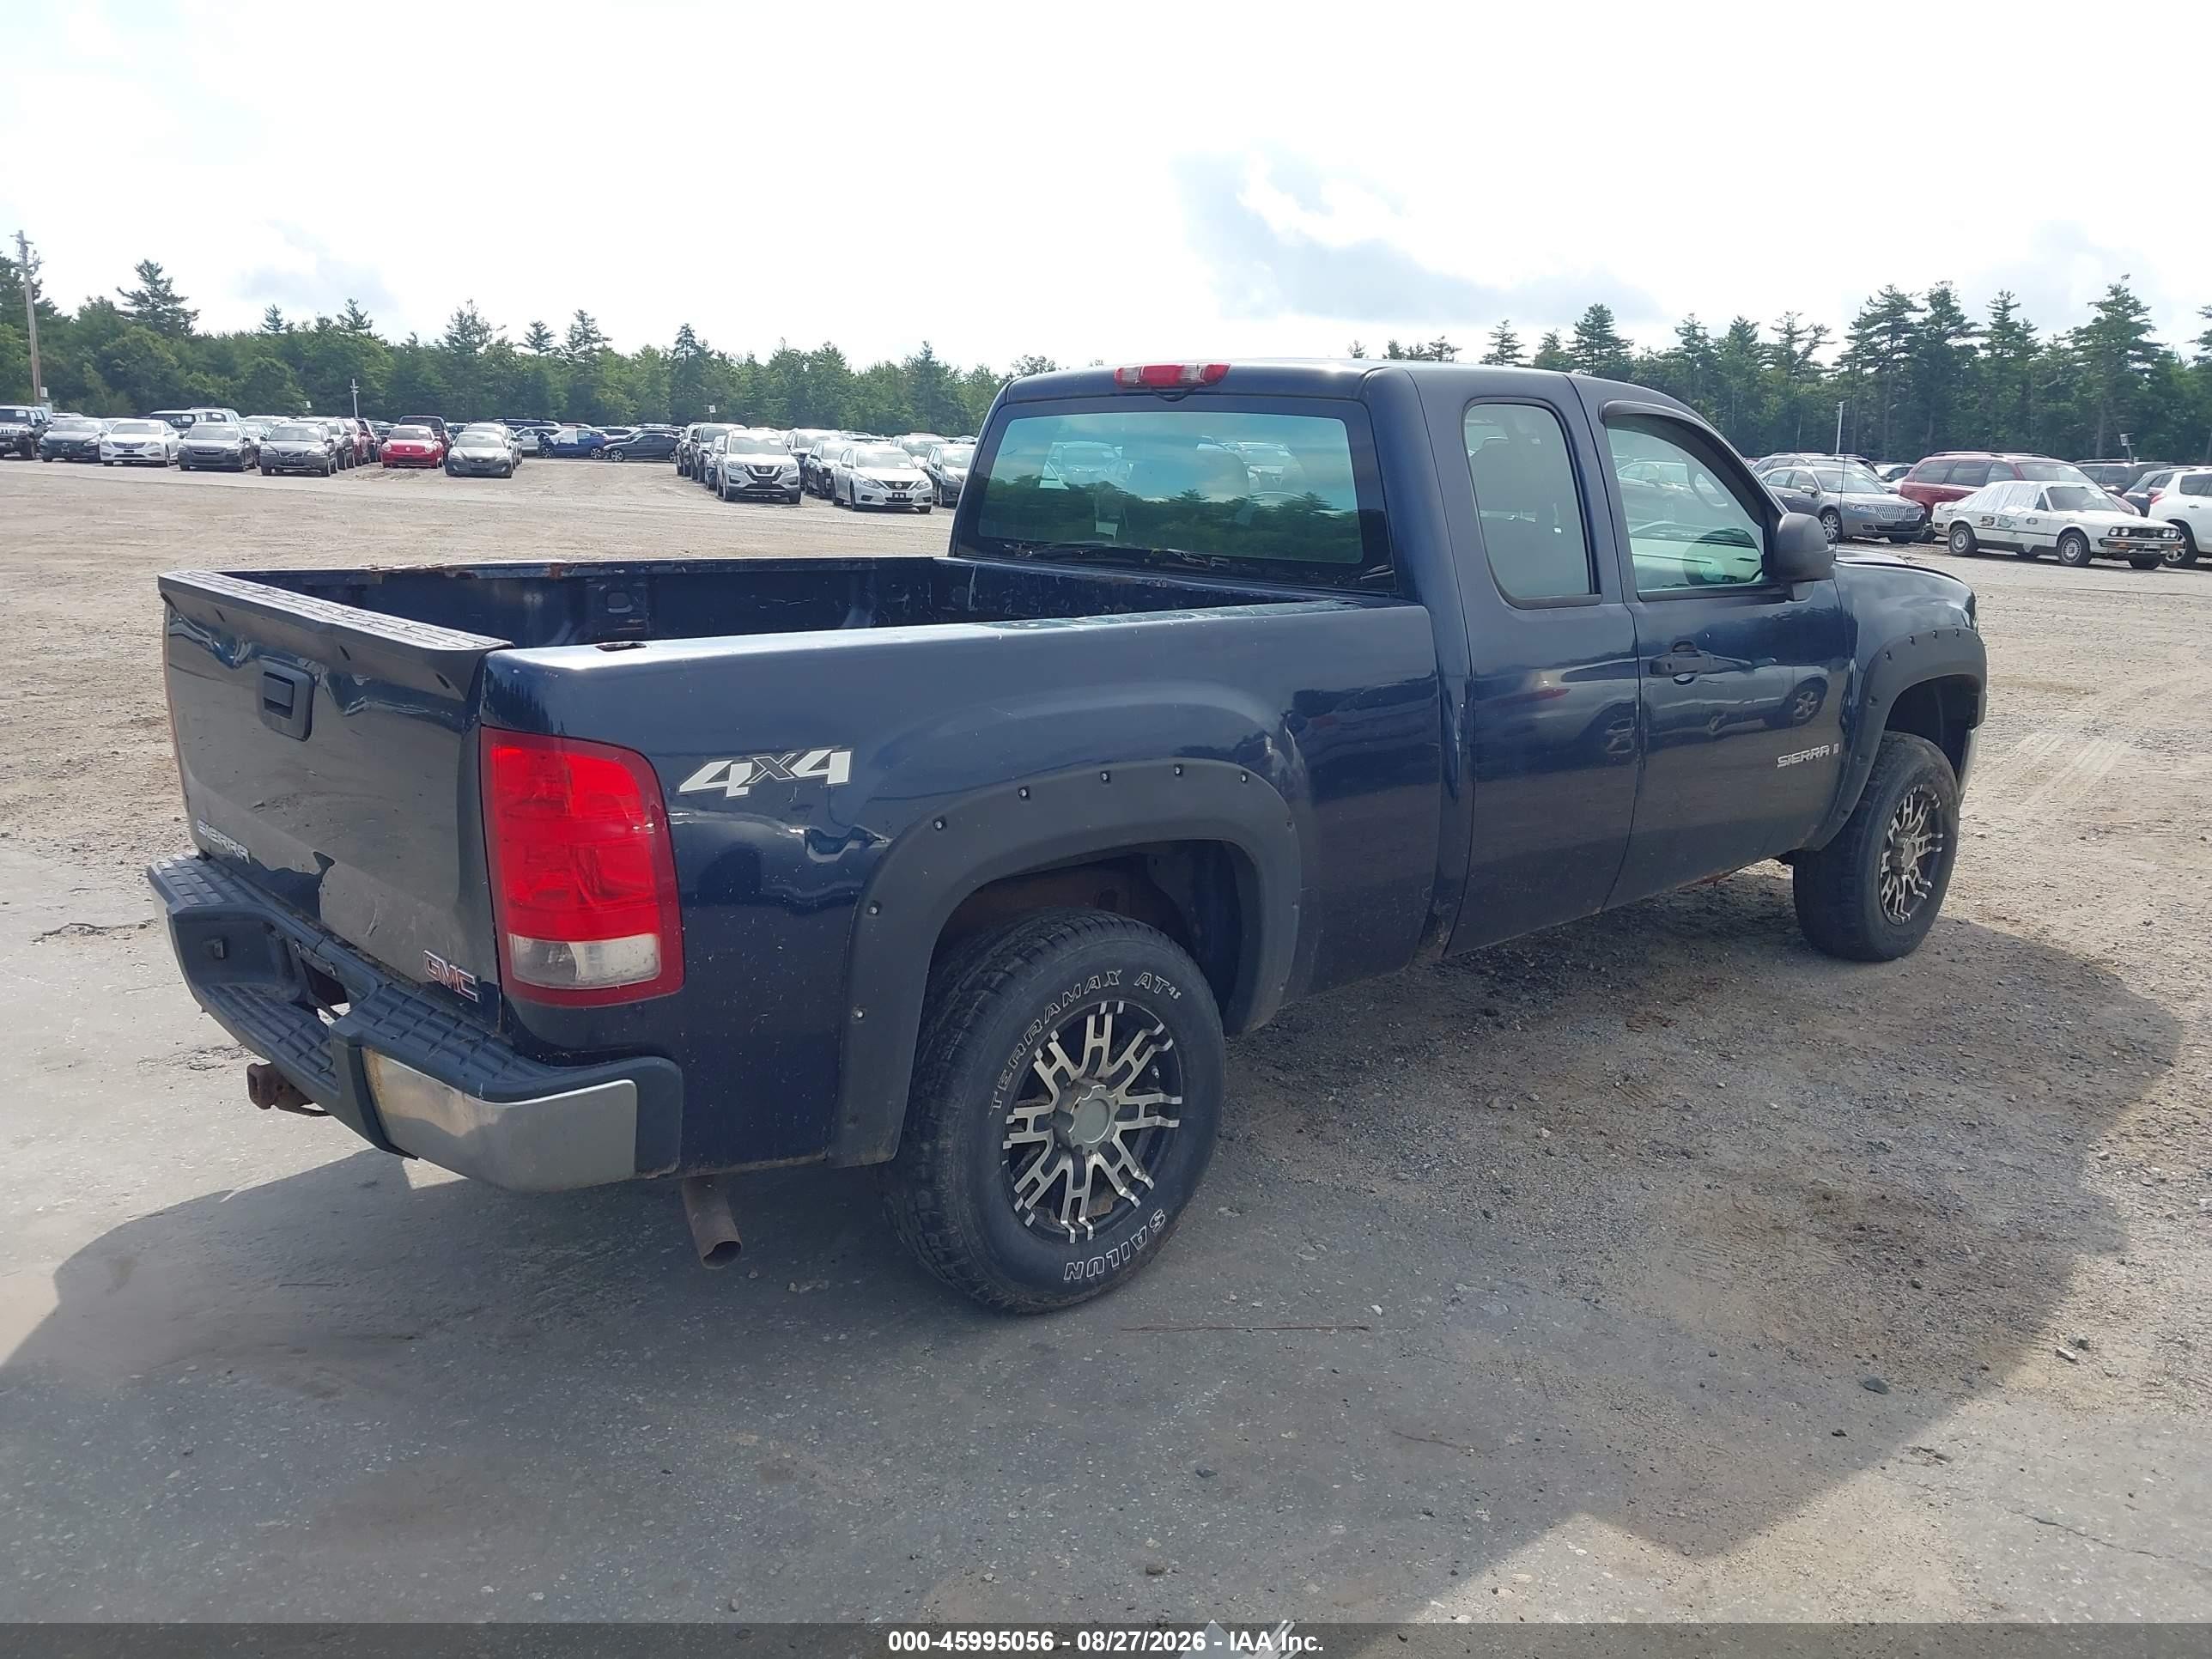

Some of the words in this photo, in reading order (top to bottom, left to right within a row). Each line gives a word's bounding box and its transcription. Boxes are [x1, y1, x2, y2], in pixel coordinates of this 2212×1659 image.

[1777, 744, 1830, 769] SIERRA
[197, 819, 250, 865] SIERRA
[423, 949, 483, 1004] GMC
[988, 969, 1121, 1116] TERRAMAX
[1063, 1208, 1167, 1281] SAILUN
